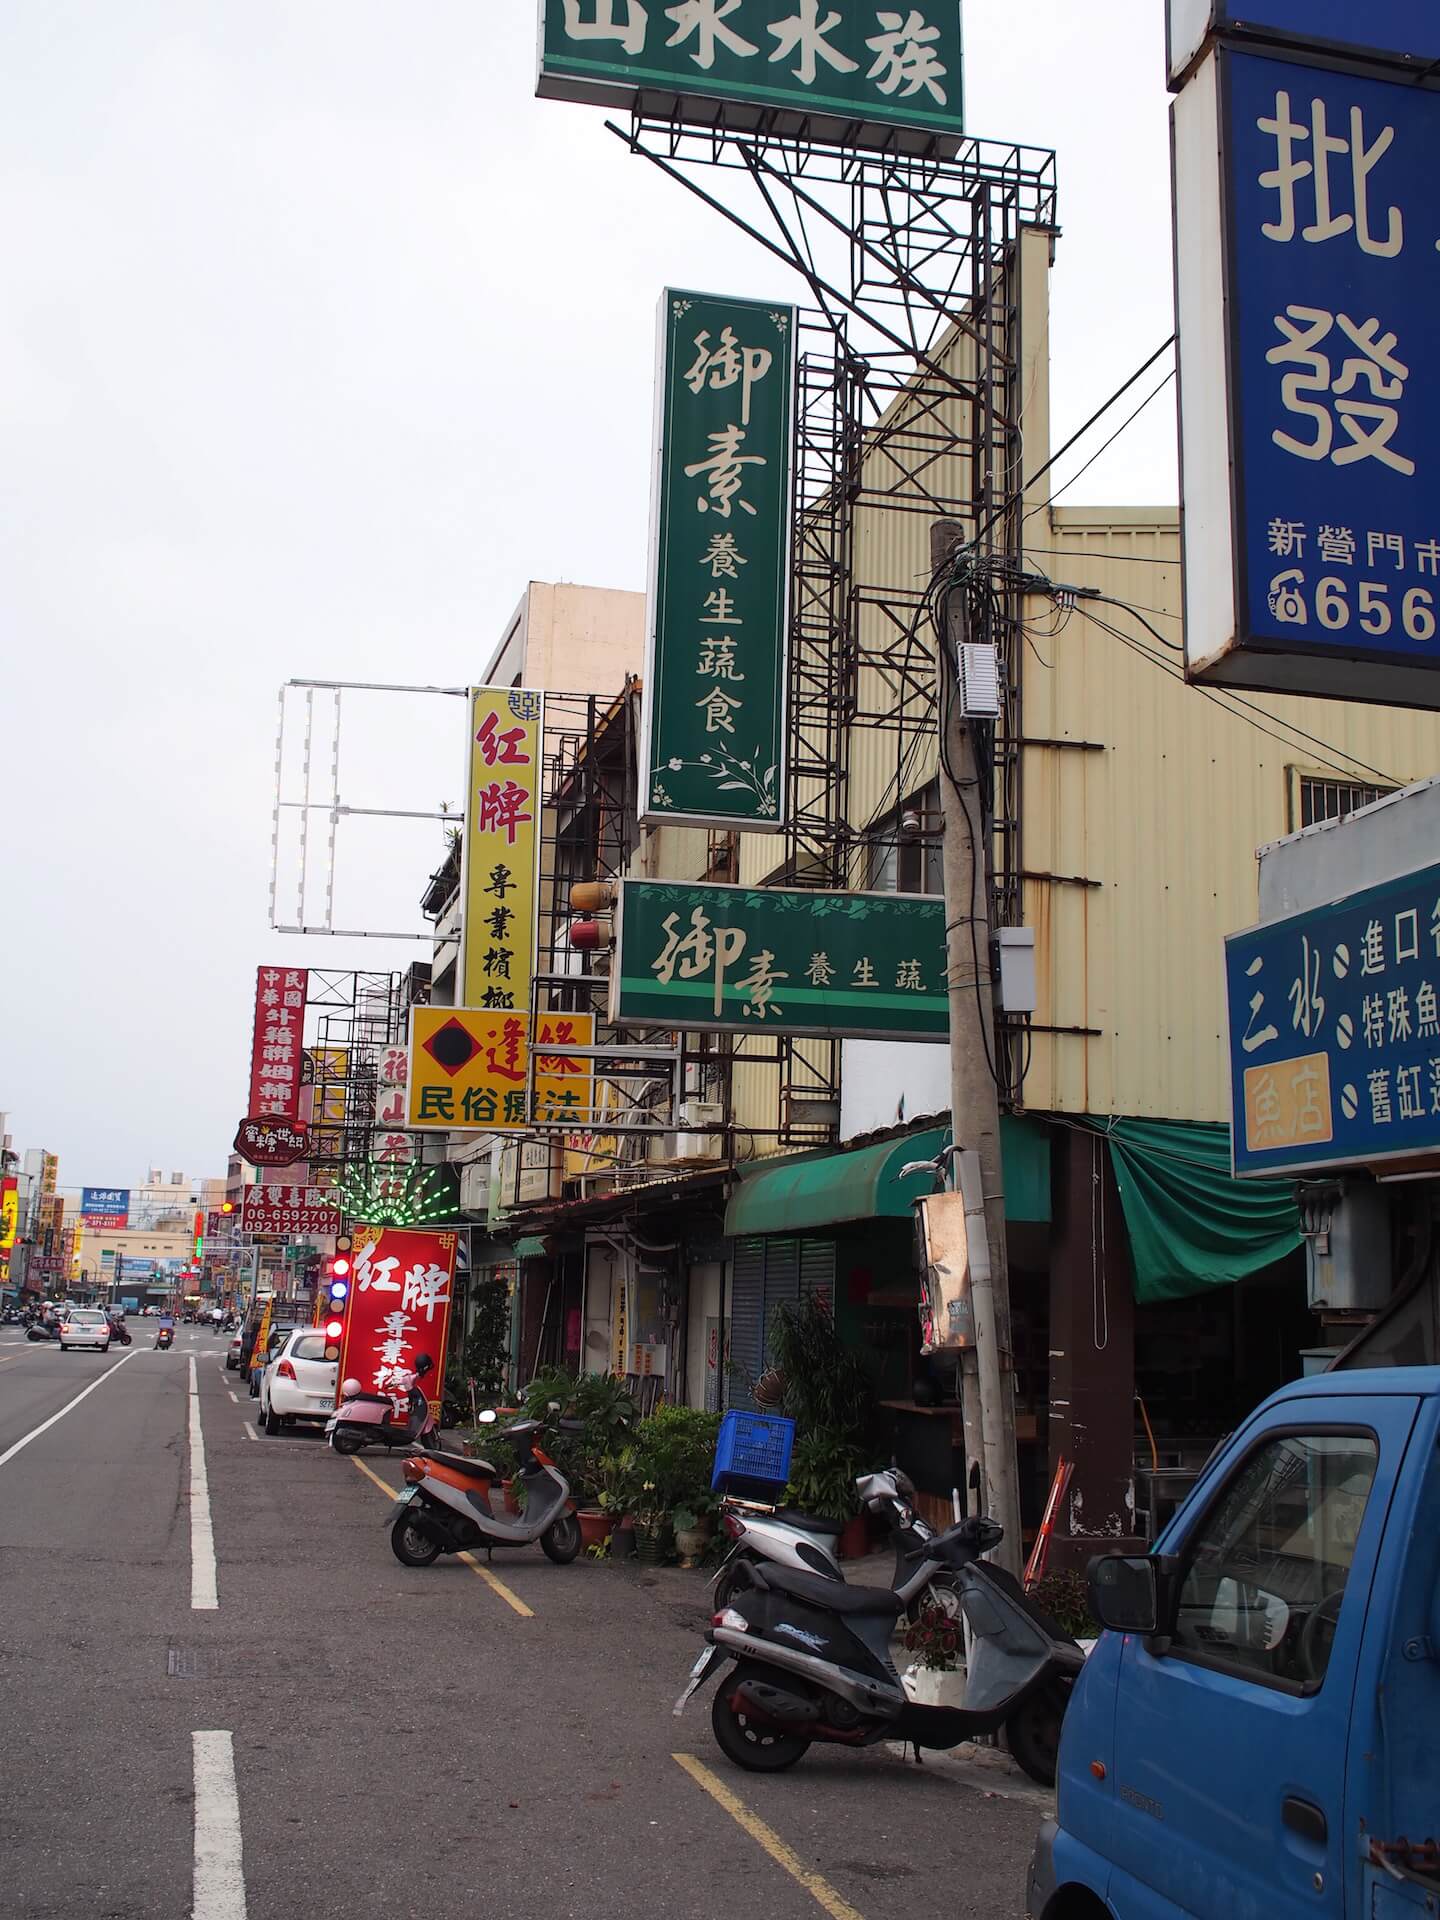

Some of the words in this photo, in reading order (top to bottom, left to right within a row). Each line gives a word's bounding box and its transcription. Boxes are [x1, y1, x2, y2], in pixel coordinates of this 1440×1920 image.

[1256, 90, 1416, 476] 批發
[683, 326, 772, 518] 御素
[1267, 517, 1440, 577] 新營門市
[695, 533, 748, 734] 養生蔬食
[1314, 576, 1436, 641] 656
[651, 904, 789, 1020] 御素
[804, 951, 948, 994] 養生蔬
[1362, 980, 1440, 1049] 特殊魚
[417, 1085, 581, 1124] 民俗療法
[244, 1220, 339, 1234] 0921242249
[247, 1208, 337, 1221] 06-6592707
[352, 1241, 451, 1323] 紅牌
